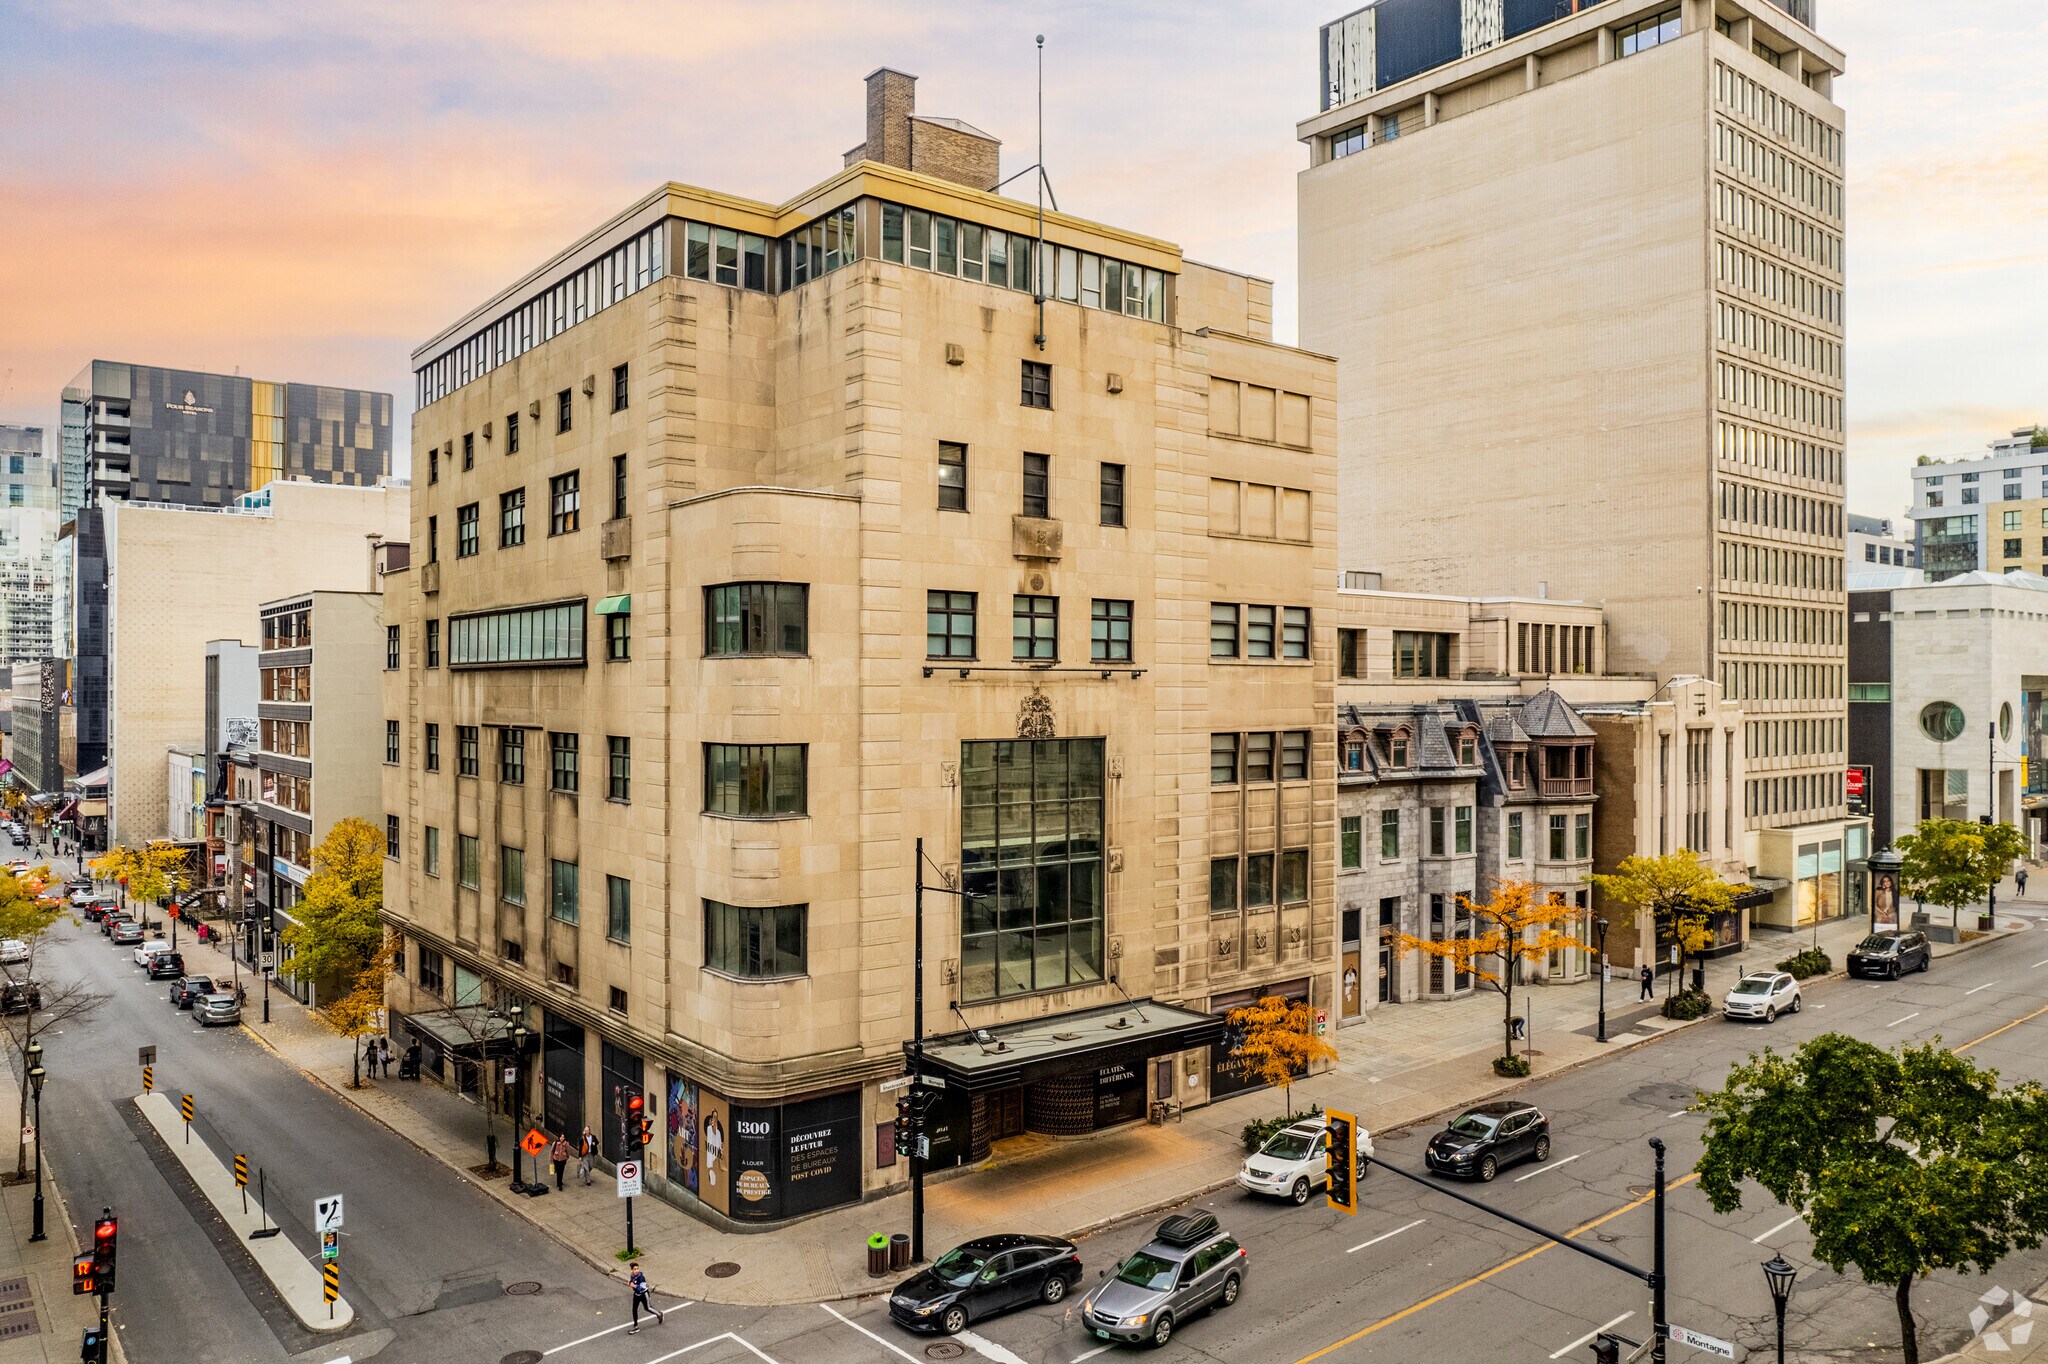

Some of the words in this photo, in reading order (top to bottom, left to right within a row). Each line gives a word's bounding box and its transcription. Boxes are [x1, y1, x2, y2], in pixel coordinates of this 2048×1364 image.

[166, 402, 184, 410] FOUR
[184, 405, 214, 413] SEASONS
[262, 955, 272, 964] 30
[882, 1081, 906, 1091] Sherbrooke
[736, 1120, 770, 1134] 1300
[790, 1129, 832, 1144] DÉCOUVREZ
[790, 1145, 800, 1154] LE
[800, 1140, 823, 1151] FUTUR
[790, 1153, 806, 1162] DES
[806, 1146, 839, 1159] ESPACES
[790, 1164, 801, 1172] DE
[802, 1156, 836, 1170] BUREAUX
[790, 1172, 808, 1182] POST
[810, 1166, 832, 1176] COVID
[1686, 1336, 1730, 1356] Montagne
